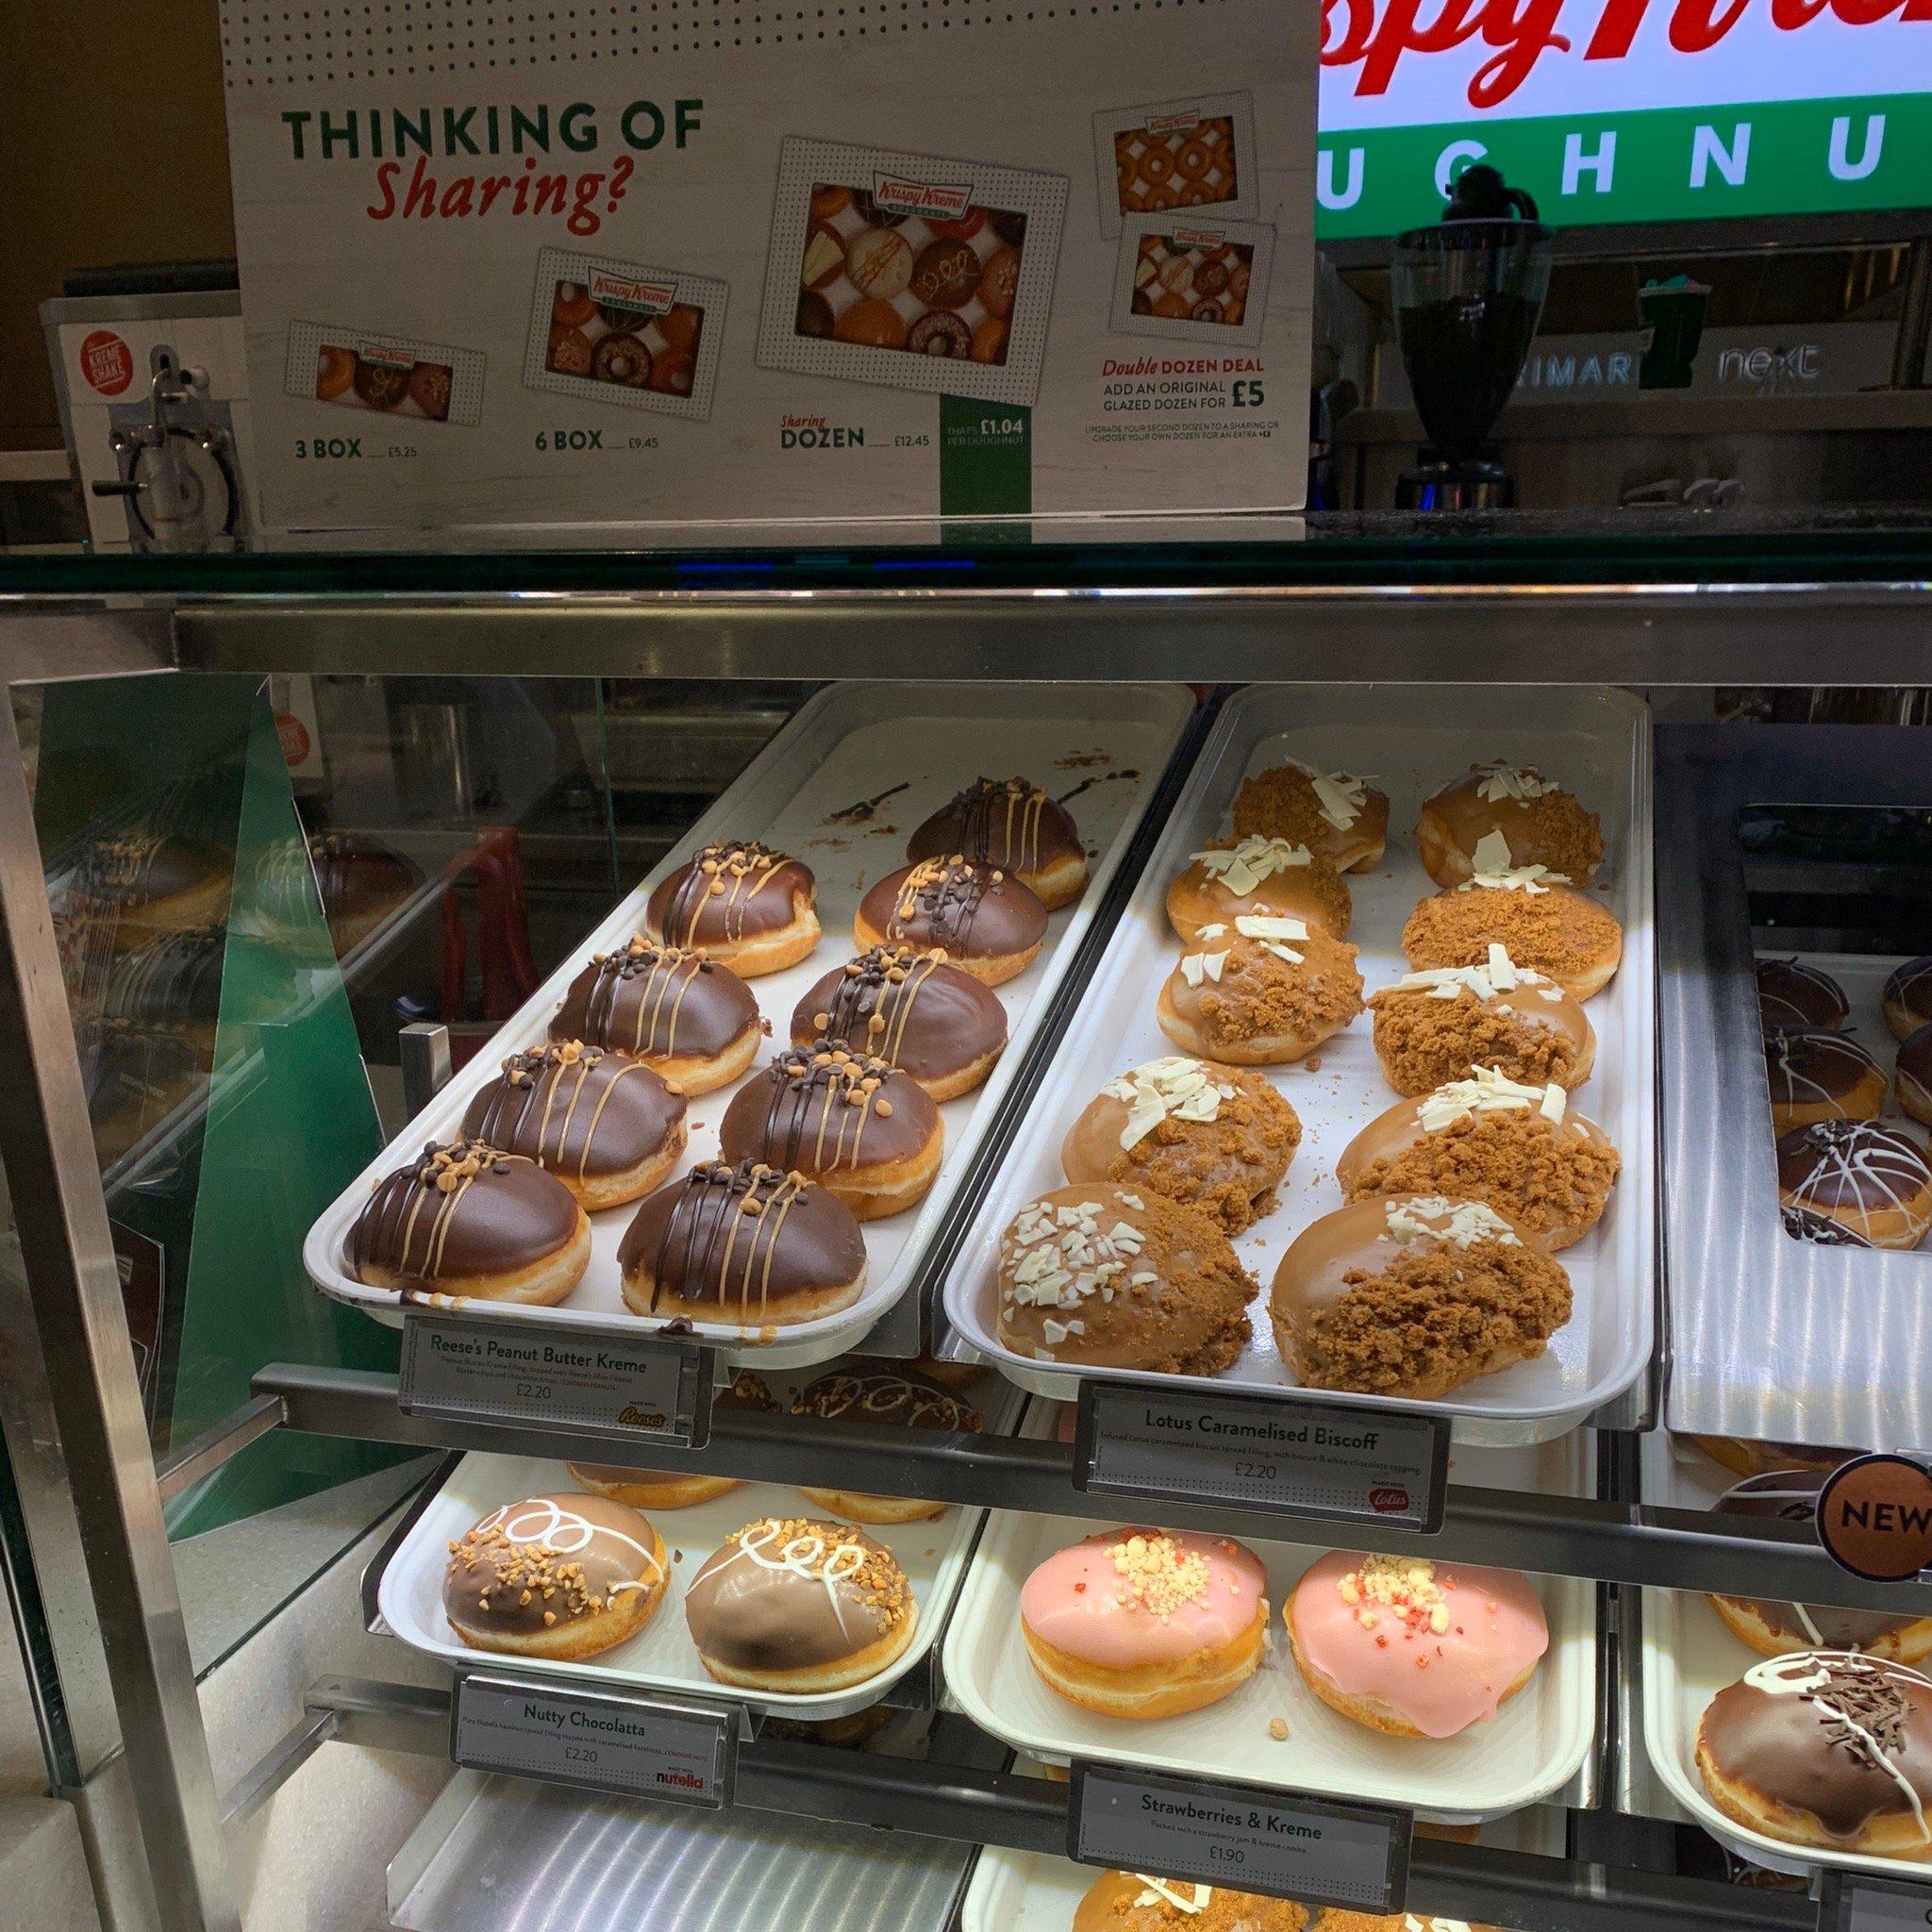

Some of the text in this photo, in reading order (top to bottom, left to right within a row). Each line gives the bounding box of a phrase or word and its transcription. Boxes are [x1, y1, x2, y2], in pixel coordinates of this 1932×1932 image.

[282, 99, 703, 159] THINKING OF
[366, 155, 635, 236] Sharing?
[1102, 356, 1264, 376] Double DOZEN DEAL
[1719, 343, 1821, 380] next
[1104, 381, 1225, 395] ADD AN ORIGINAL
[1232, 380, 1265, 408] £5
[1104, 397, 1225, 411] GLAZED DOZEN FOR
[780, 414, 826, 428] Sharing
[981, 418, 1024, 435] £1.04
[1124, 425, 1145, 433] YOUR
[1147, 424, 1180, 432] SECOND
[1182, 423, 1209, 431] DOZEN
[535, 429, 659, 451] 6 BOX £9.45
[781, 427, 929, 449] DOZEN £12.45
[1151, 433, 1171, 441] OWN
[1173, 432, 1200, 441] DOZEN
[295, 438, 417, 458] 3 BOX £5.25
[431, 1334, 646, 1374] Reese's Peanut Butter Kreme
[516, 1383, 551, 1399] £2.20
[1145, 1409, 1378, 1450] Lotus Caramelised Biscoff
[1235, 1461, 1277, 1480] £2.20
[1840, 1500, 1932, 1535] NEW
[525, 1704, 645, 1737] Nutty Chocolatta
[565, 1746, 598, 1763] £2.20
[657, 1772, 704, 1790] nutella
[1141, 1794, 1322, 1840] Strawberries & Kreme
[1209, 1845, 1244, 1863] £1.90
